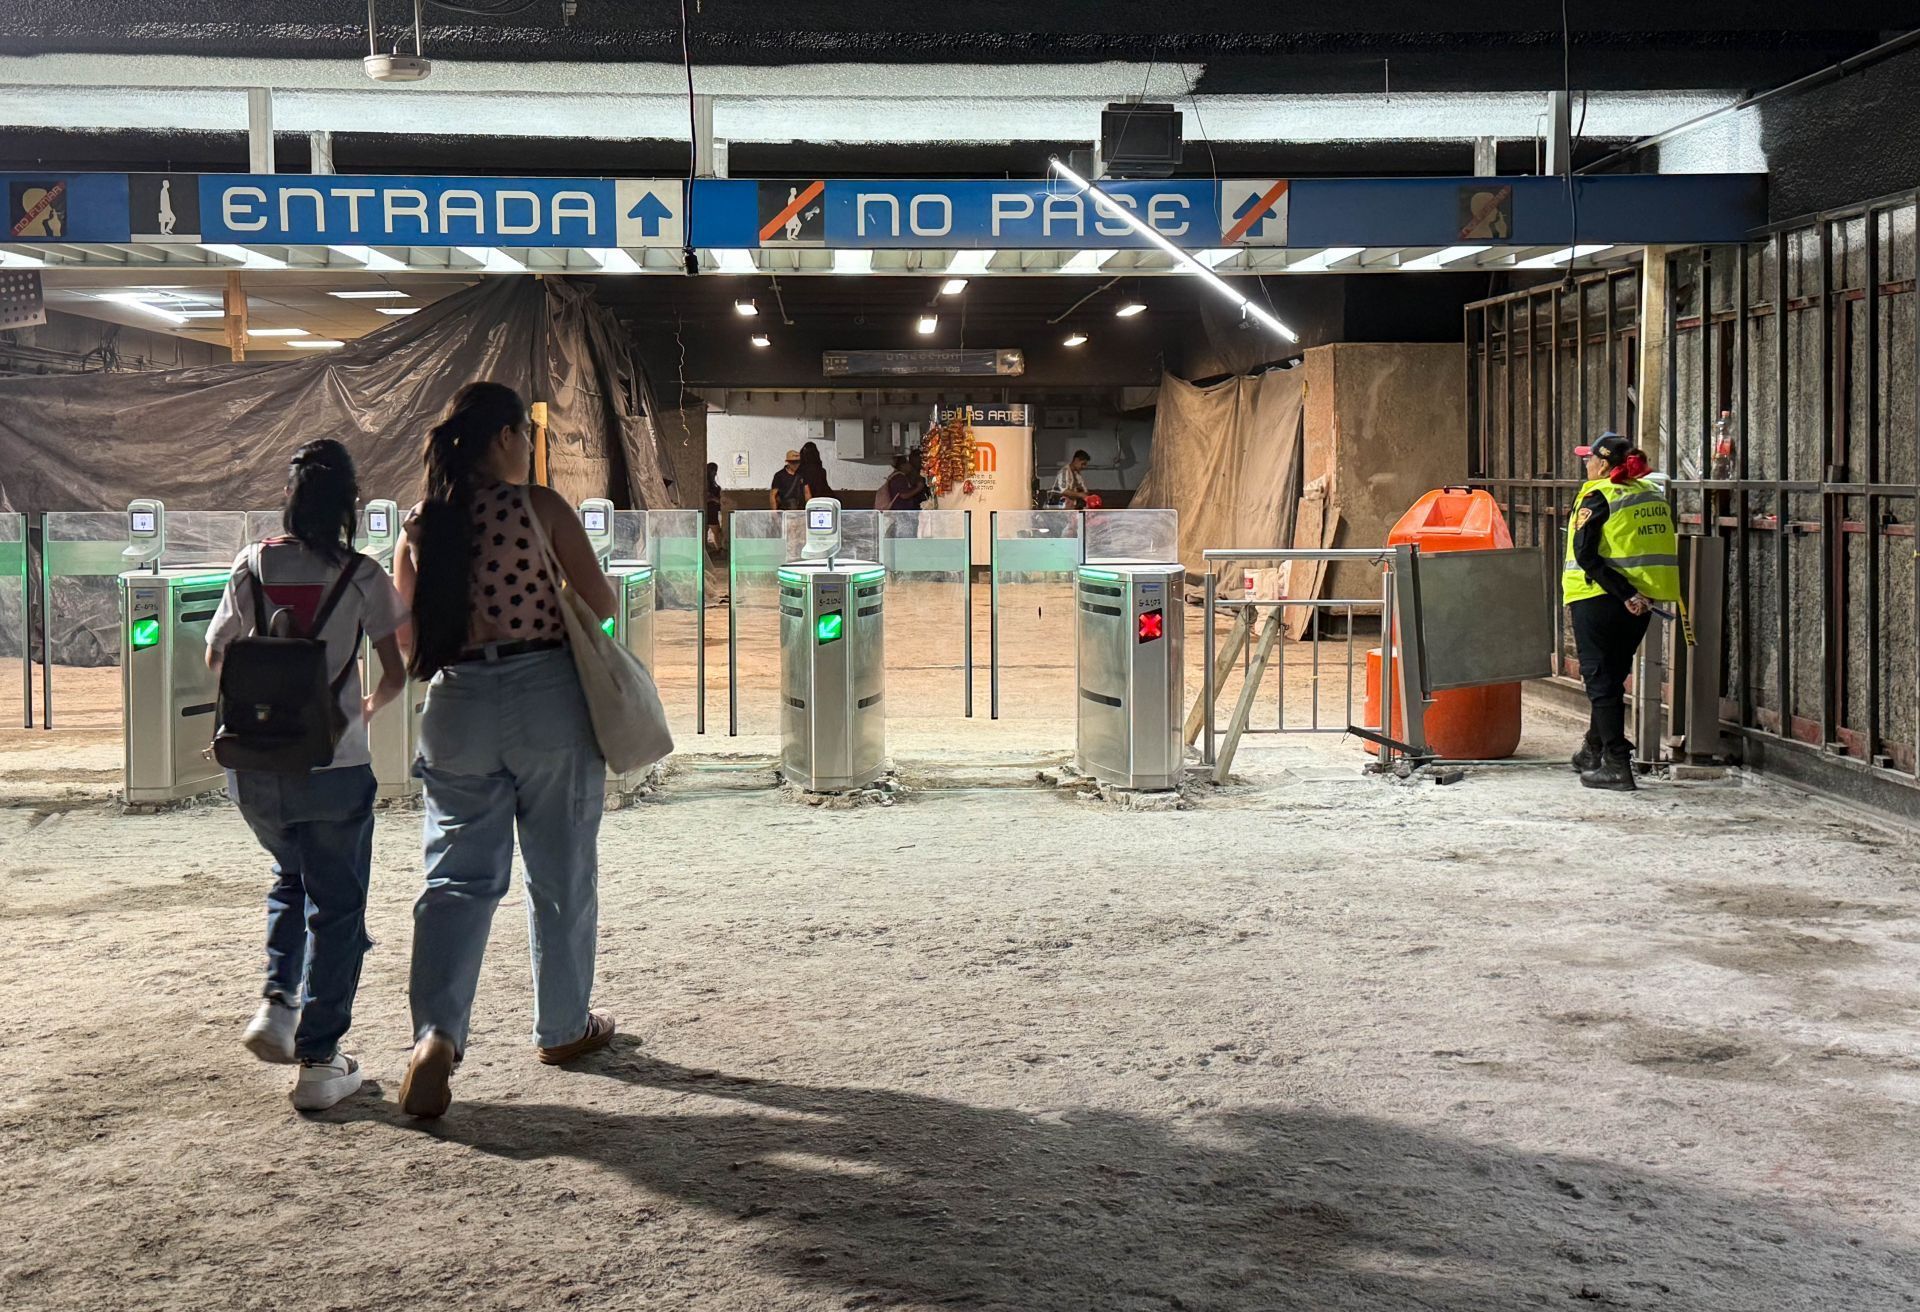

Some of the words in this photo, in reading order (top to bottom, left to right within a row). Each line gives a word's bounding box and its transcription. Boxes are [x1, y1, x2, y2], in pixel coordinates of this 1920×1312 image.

[14, 218, 29, 232] NO
[29, 185, 64, 218] FUMAR
[222, 186, 597, 236] ENTRADA
[857, 193, 953, 237] NO
[991, 193, 1190, 237] PASE
[988, 410, 1025, 422] ARTES
